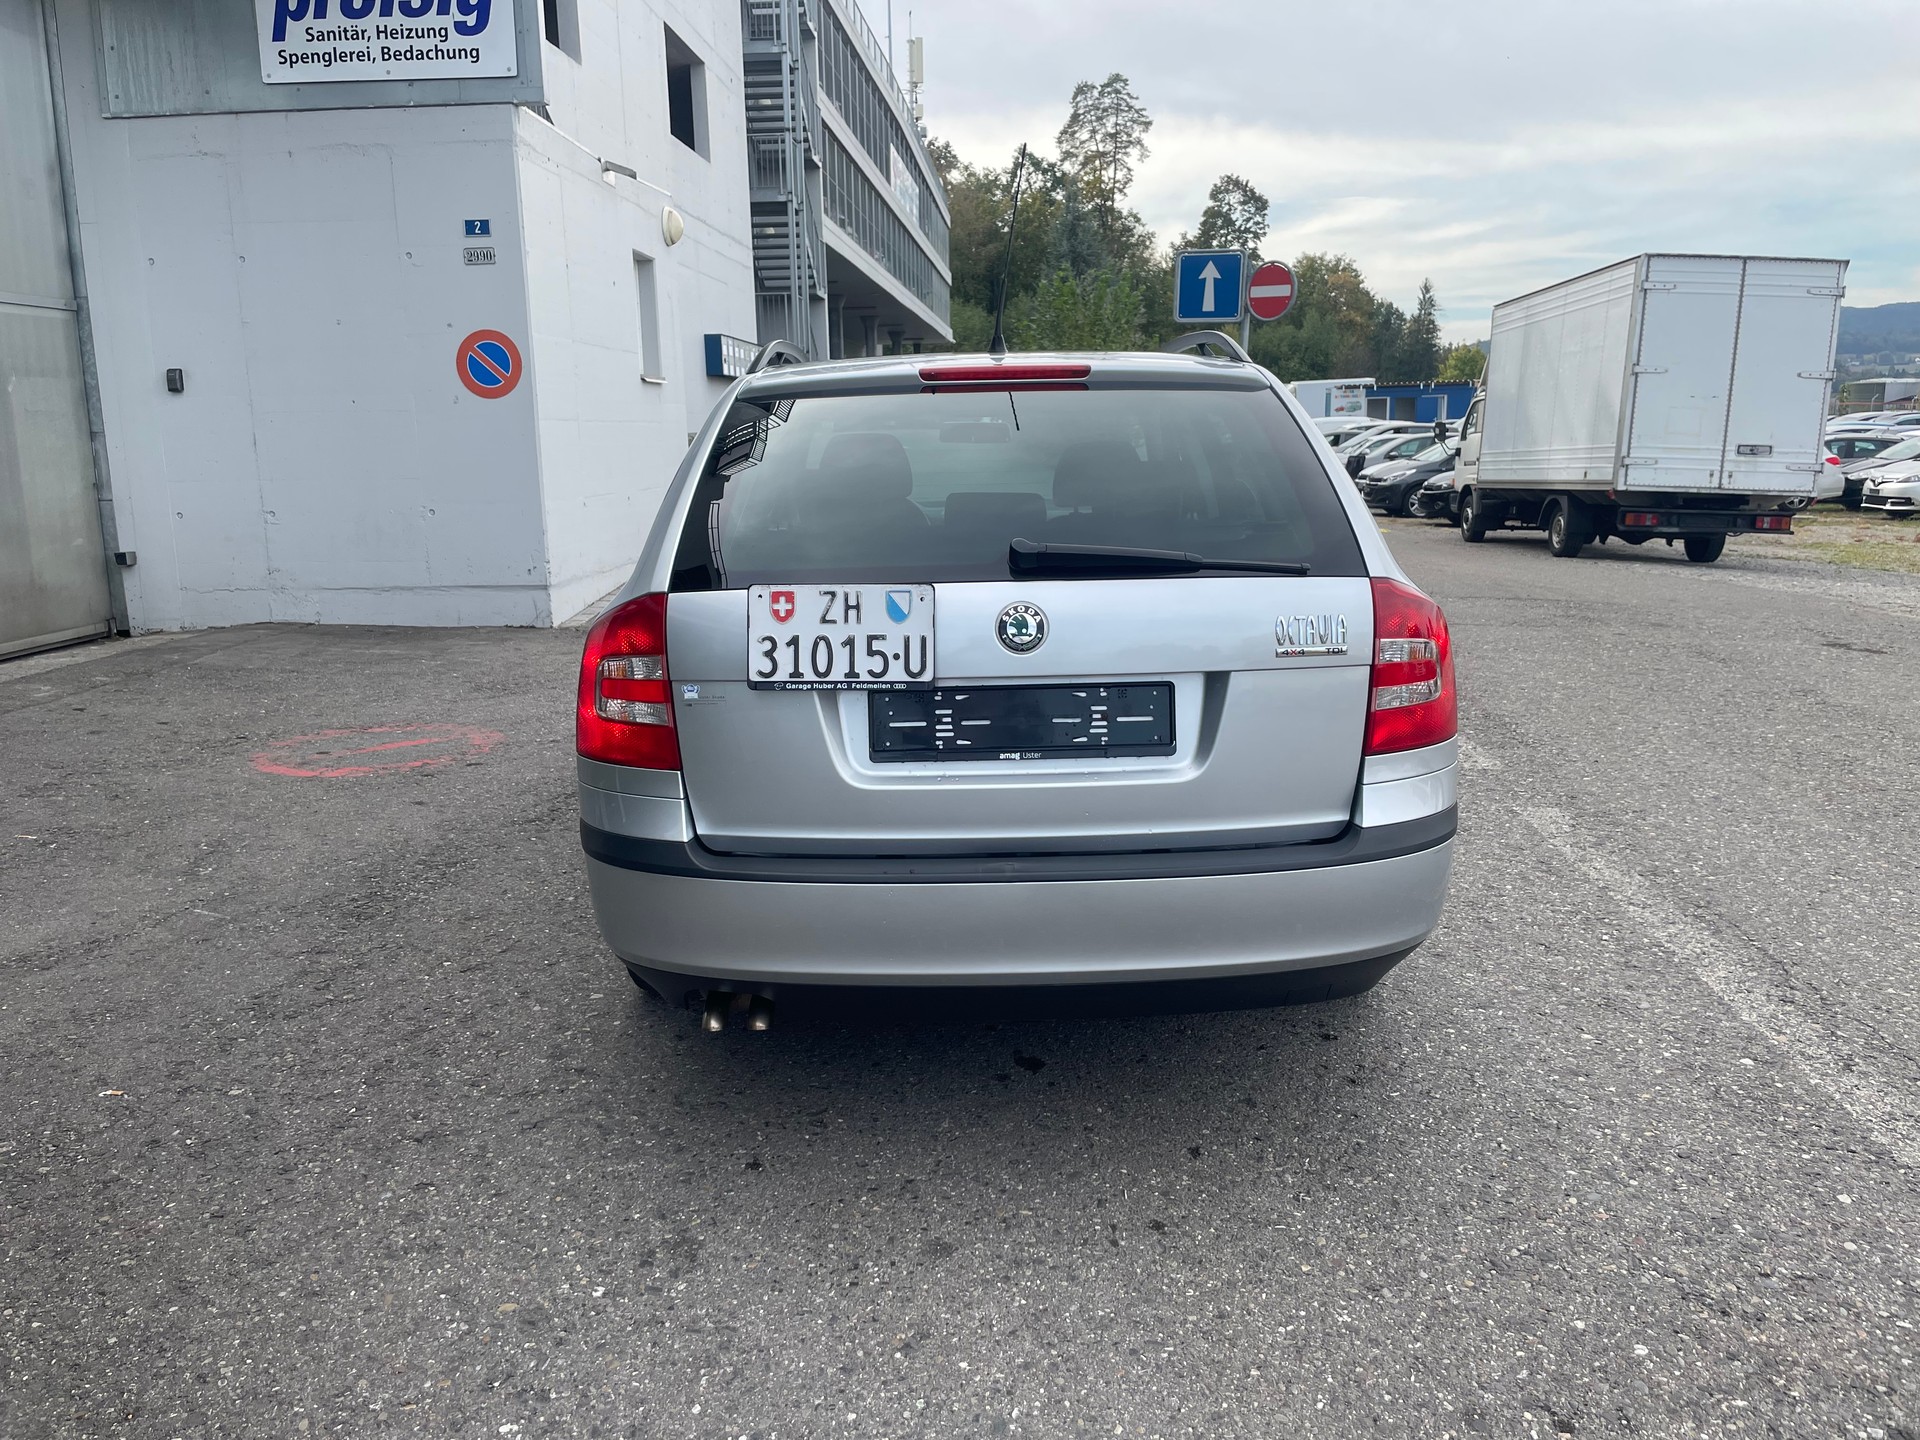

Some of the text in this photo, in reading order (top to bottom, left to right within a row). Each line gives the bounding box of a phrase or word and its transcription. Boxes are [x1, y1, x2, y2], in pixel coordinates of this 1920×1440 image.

[305, 24, 449, 43] Sanitär, Heizung
[277, 46, 480, 68] Spenglerei, Bedachung
[474, 221, 482, 233] 2
[466, 250, 492, 262] 2990
[819, 590, 862, 624] ZH
[1275, 614, 1347, 646] OCTAVIA
[999, 752, 1020, 760] amag
